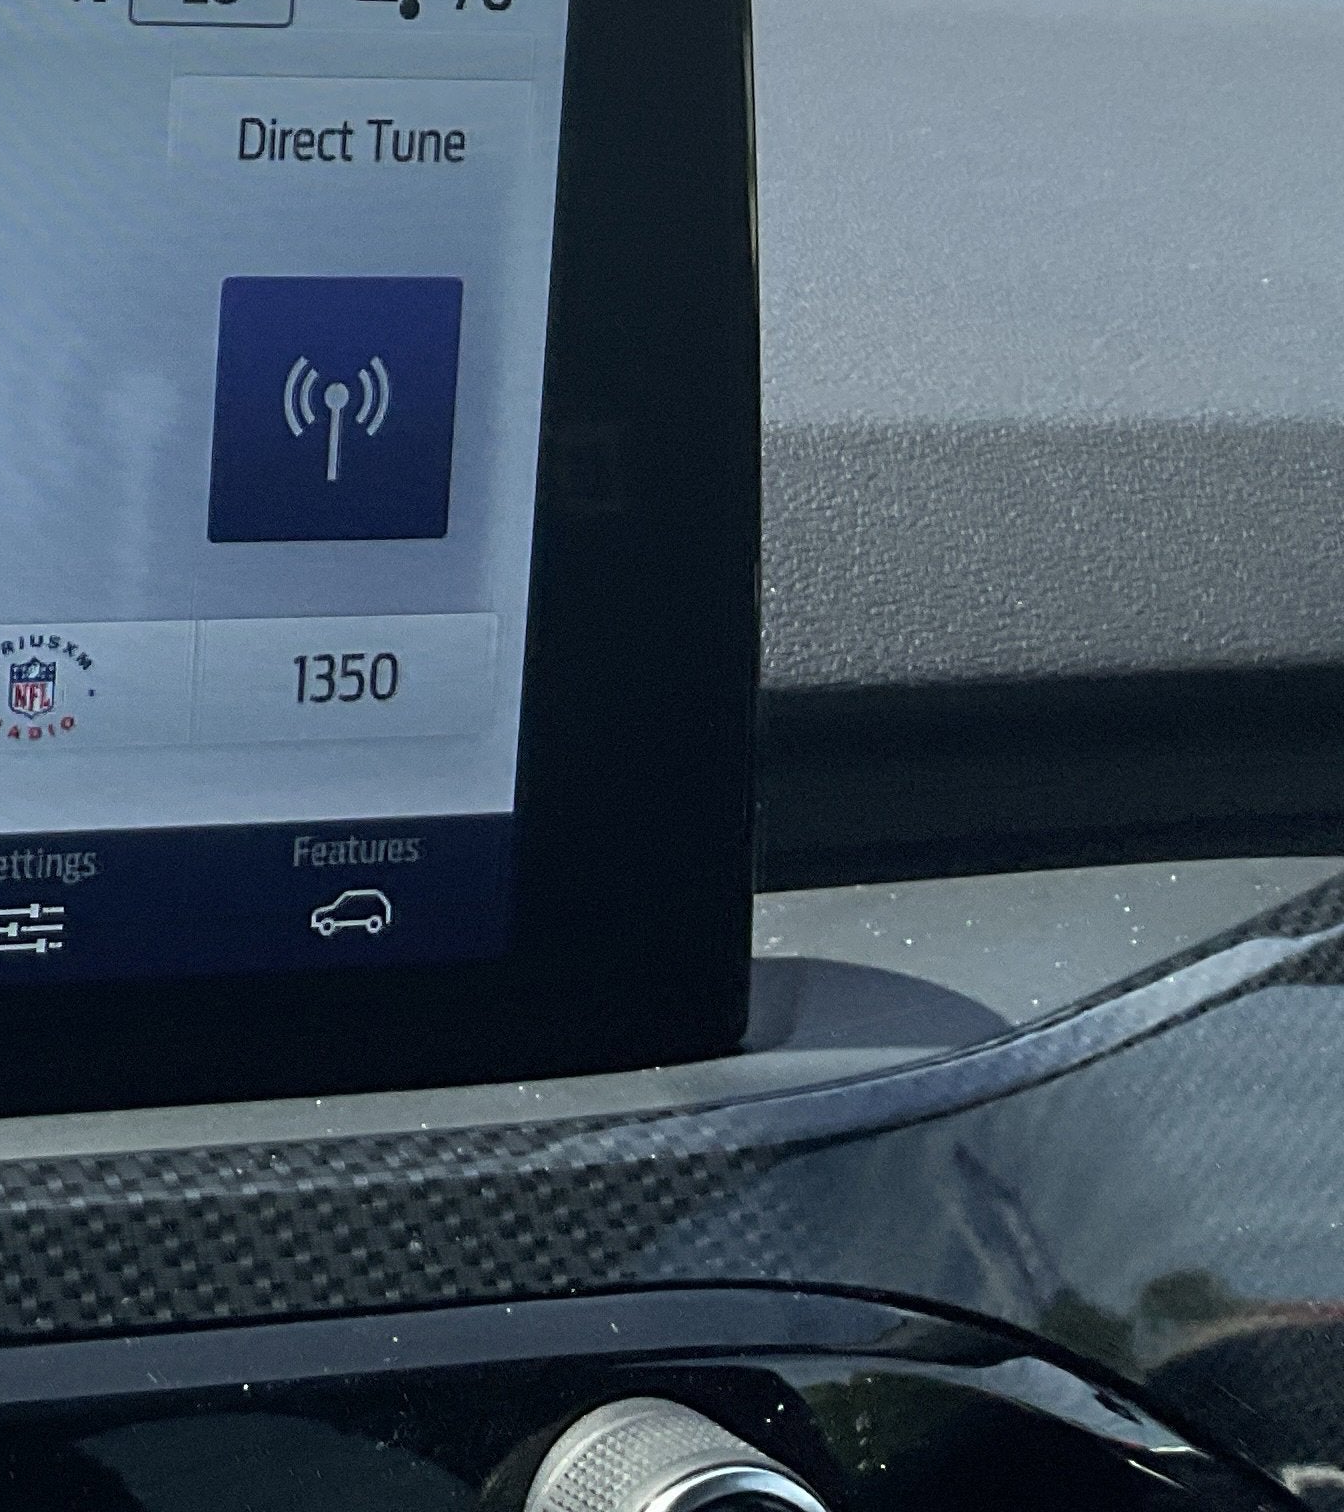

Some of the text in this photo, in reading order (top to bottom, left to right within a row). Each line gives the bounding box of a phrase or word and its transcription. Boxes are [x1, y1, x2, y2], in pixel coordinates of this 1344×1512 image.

[238, 117, 467, 164] Direct Tune
[13, 682, 51, 712] NFL
[293, 652, 400, 705] 1350
[292, 834, 422, 868] Features
